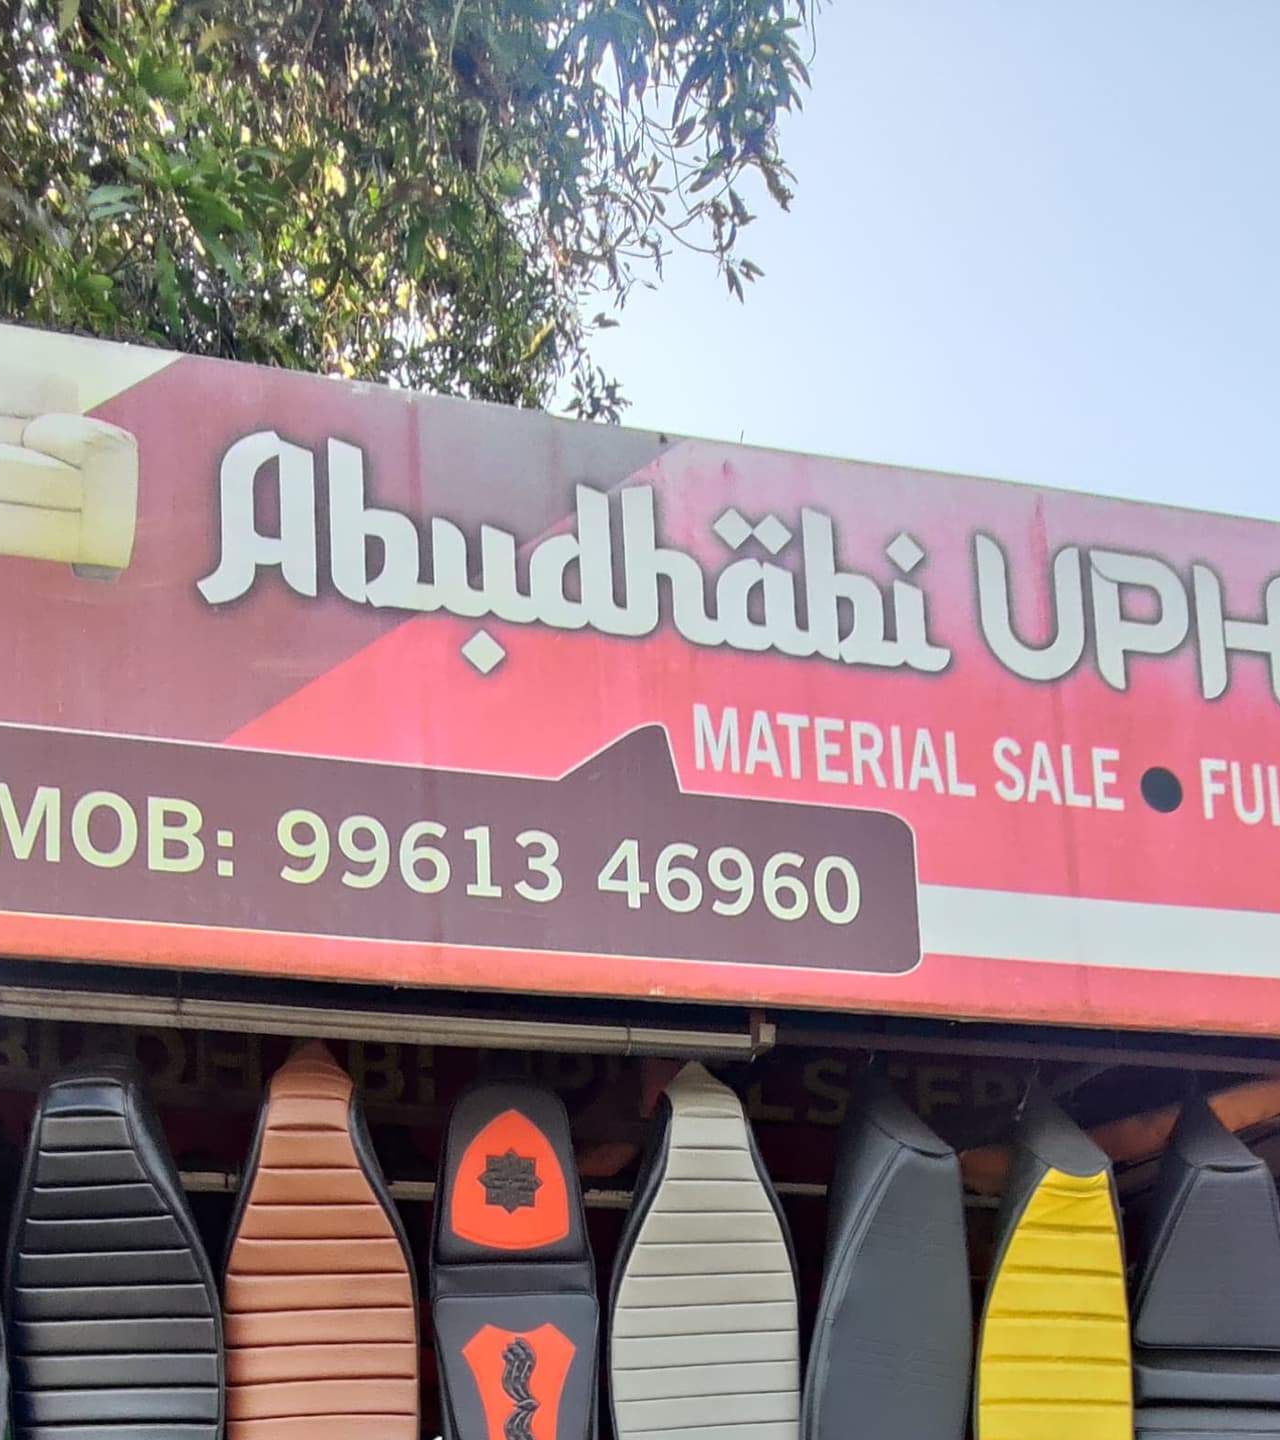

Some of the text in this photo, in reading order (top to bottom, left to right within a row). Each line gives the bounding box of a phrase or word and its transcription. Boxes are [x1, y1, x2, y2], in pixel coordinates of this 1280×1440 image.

[693, 703, 975, 797] MATERIAL
[994, 738, 1125, 811] SALE
[277, 808, 563, 903] 99613
[597, 838, 862, 925] 46960
